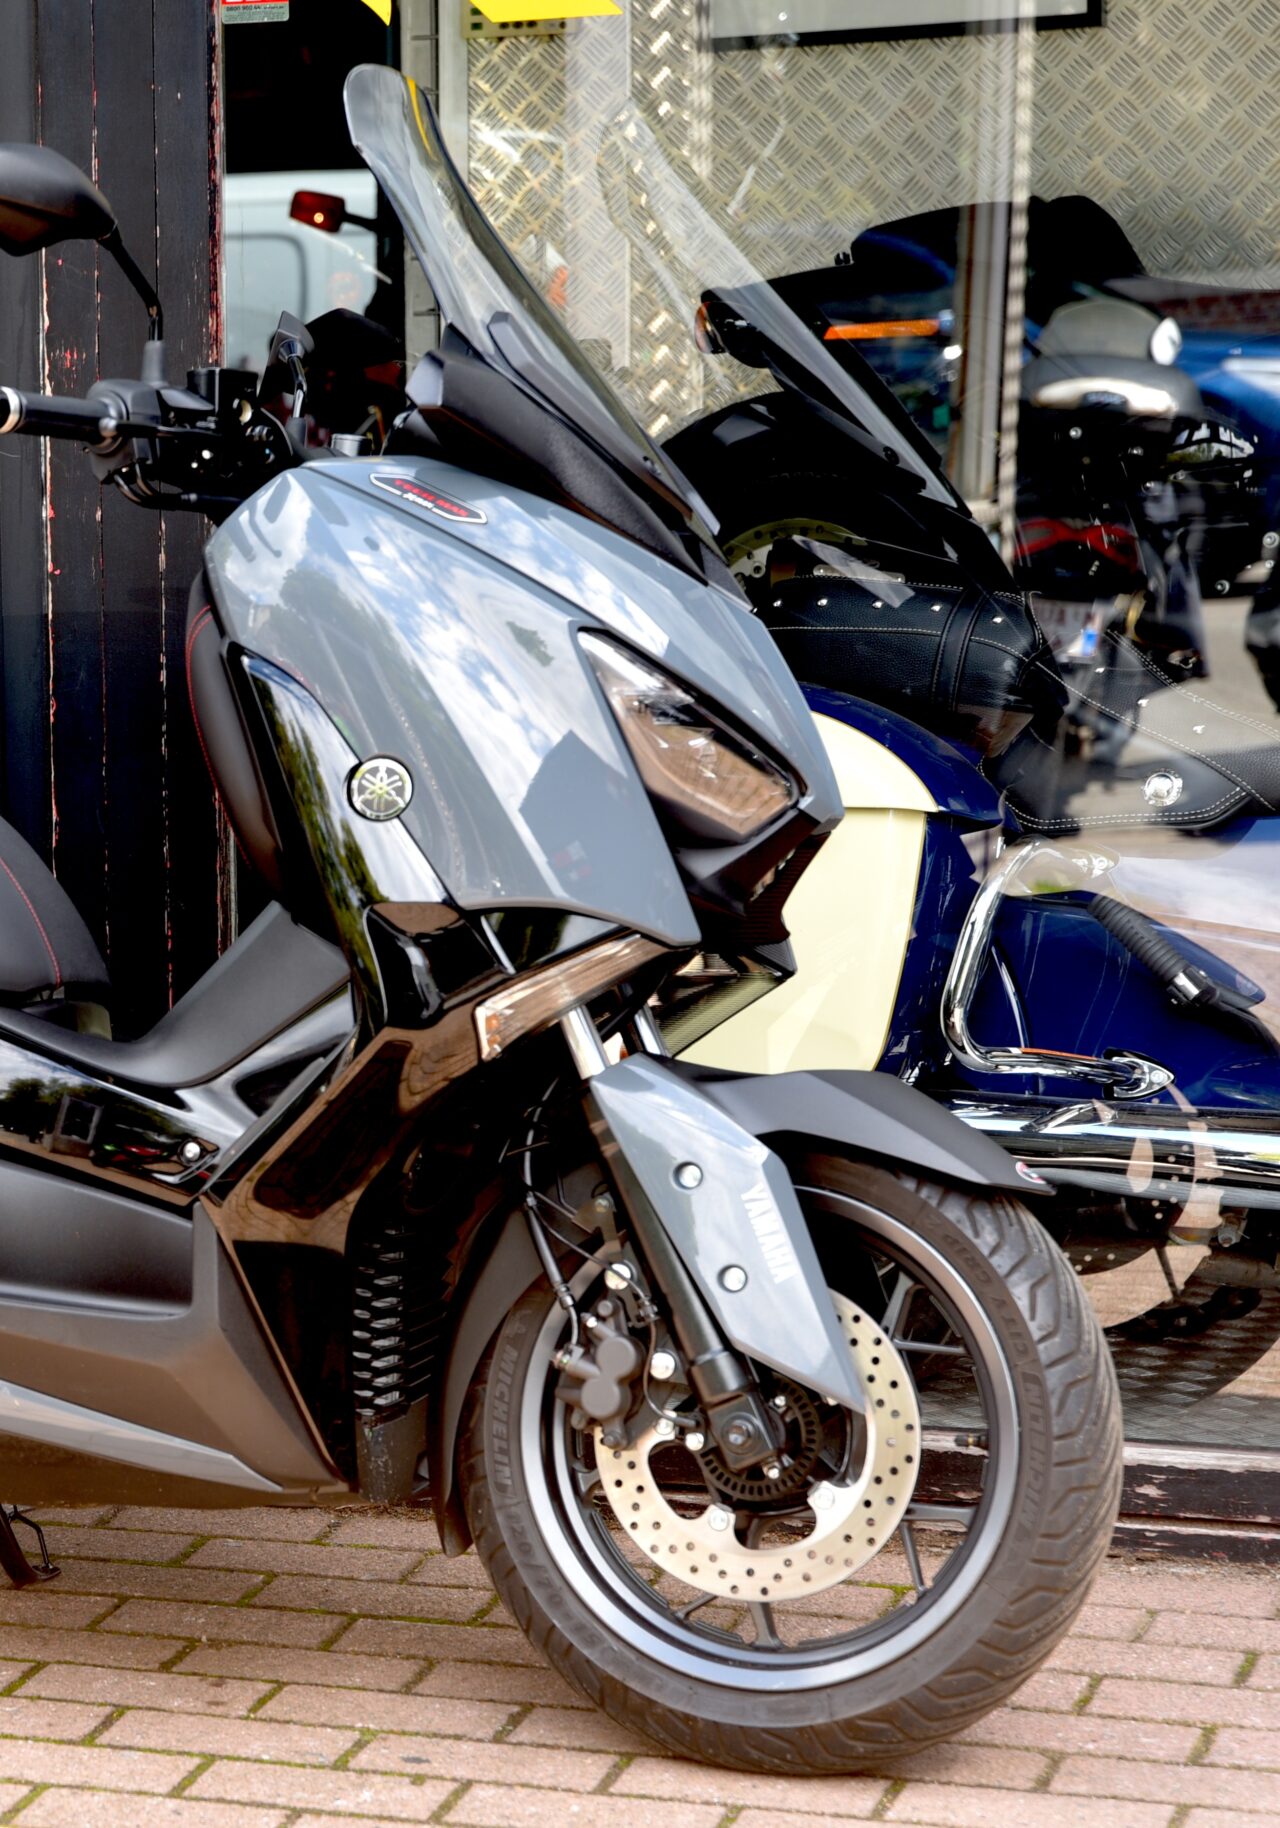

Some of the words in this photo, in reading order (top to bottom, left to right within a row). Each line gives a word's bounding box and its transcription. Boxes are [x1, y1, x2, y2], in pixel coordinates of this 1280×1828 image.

[740, 1181, 801, 1285] YAMAHA
[492, 1343, 519, 1486] MICHELIN
[1019, 1382, 1047, 1530] MICHELIN
